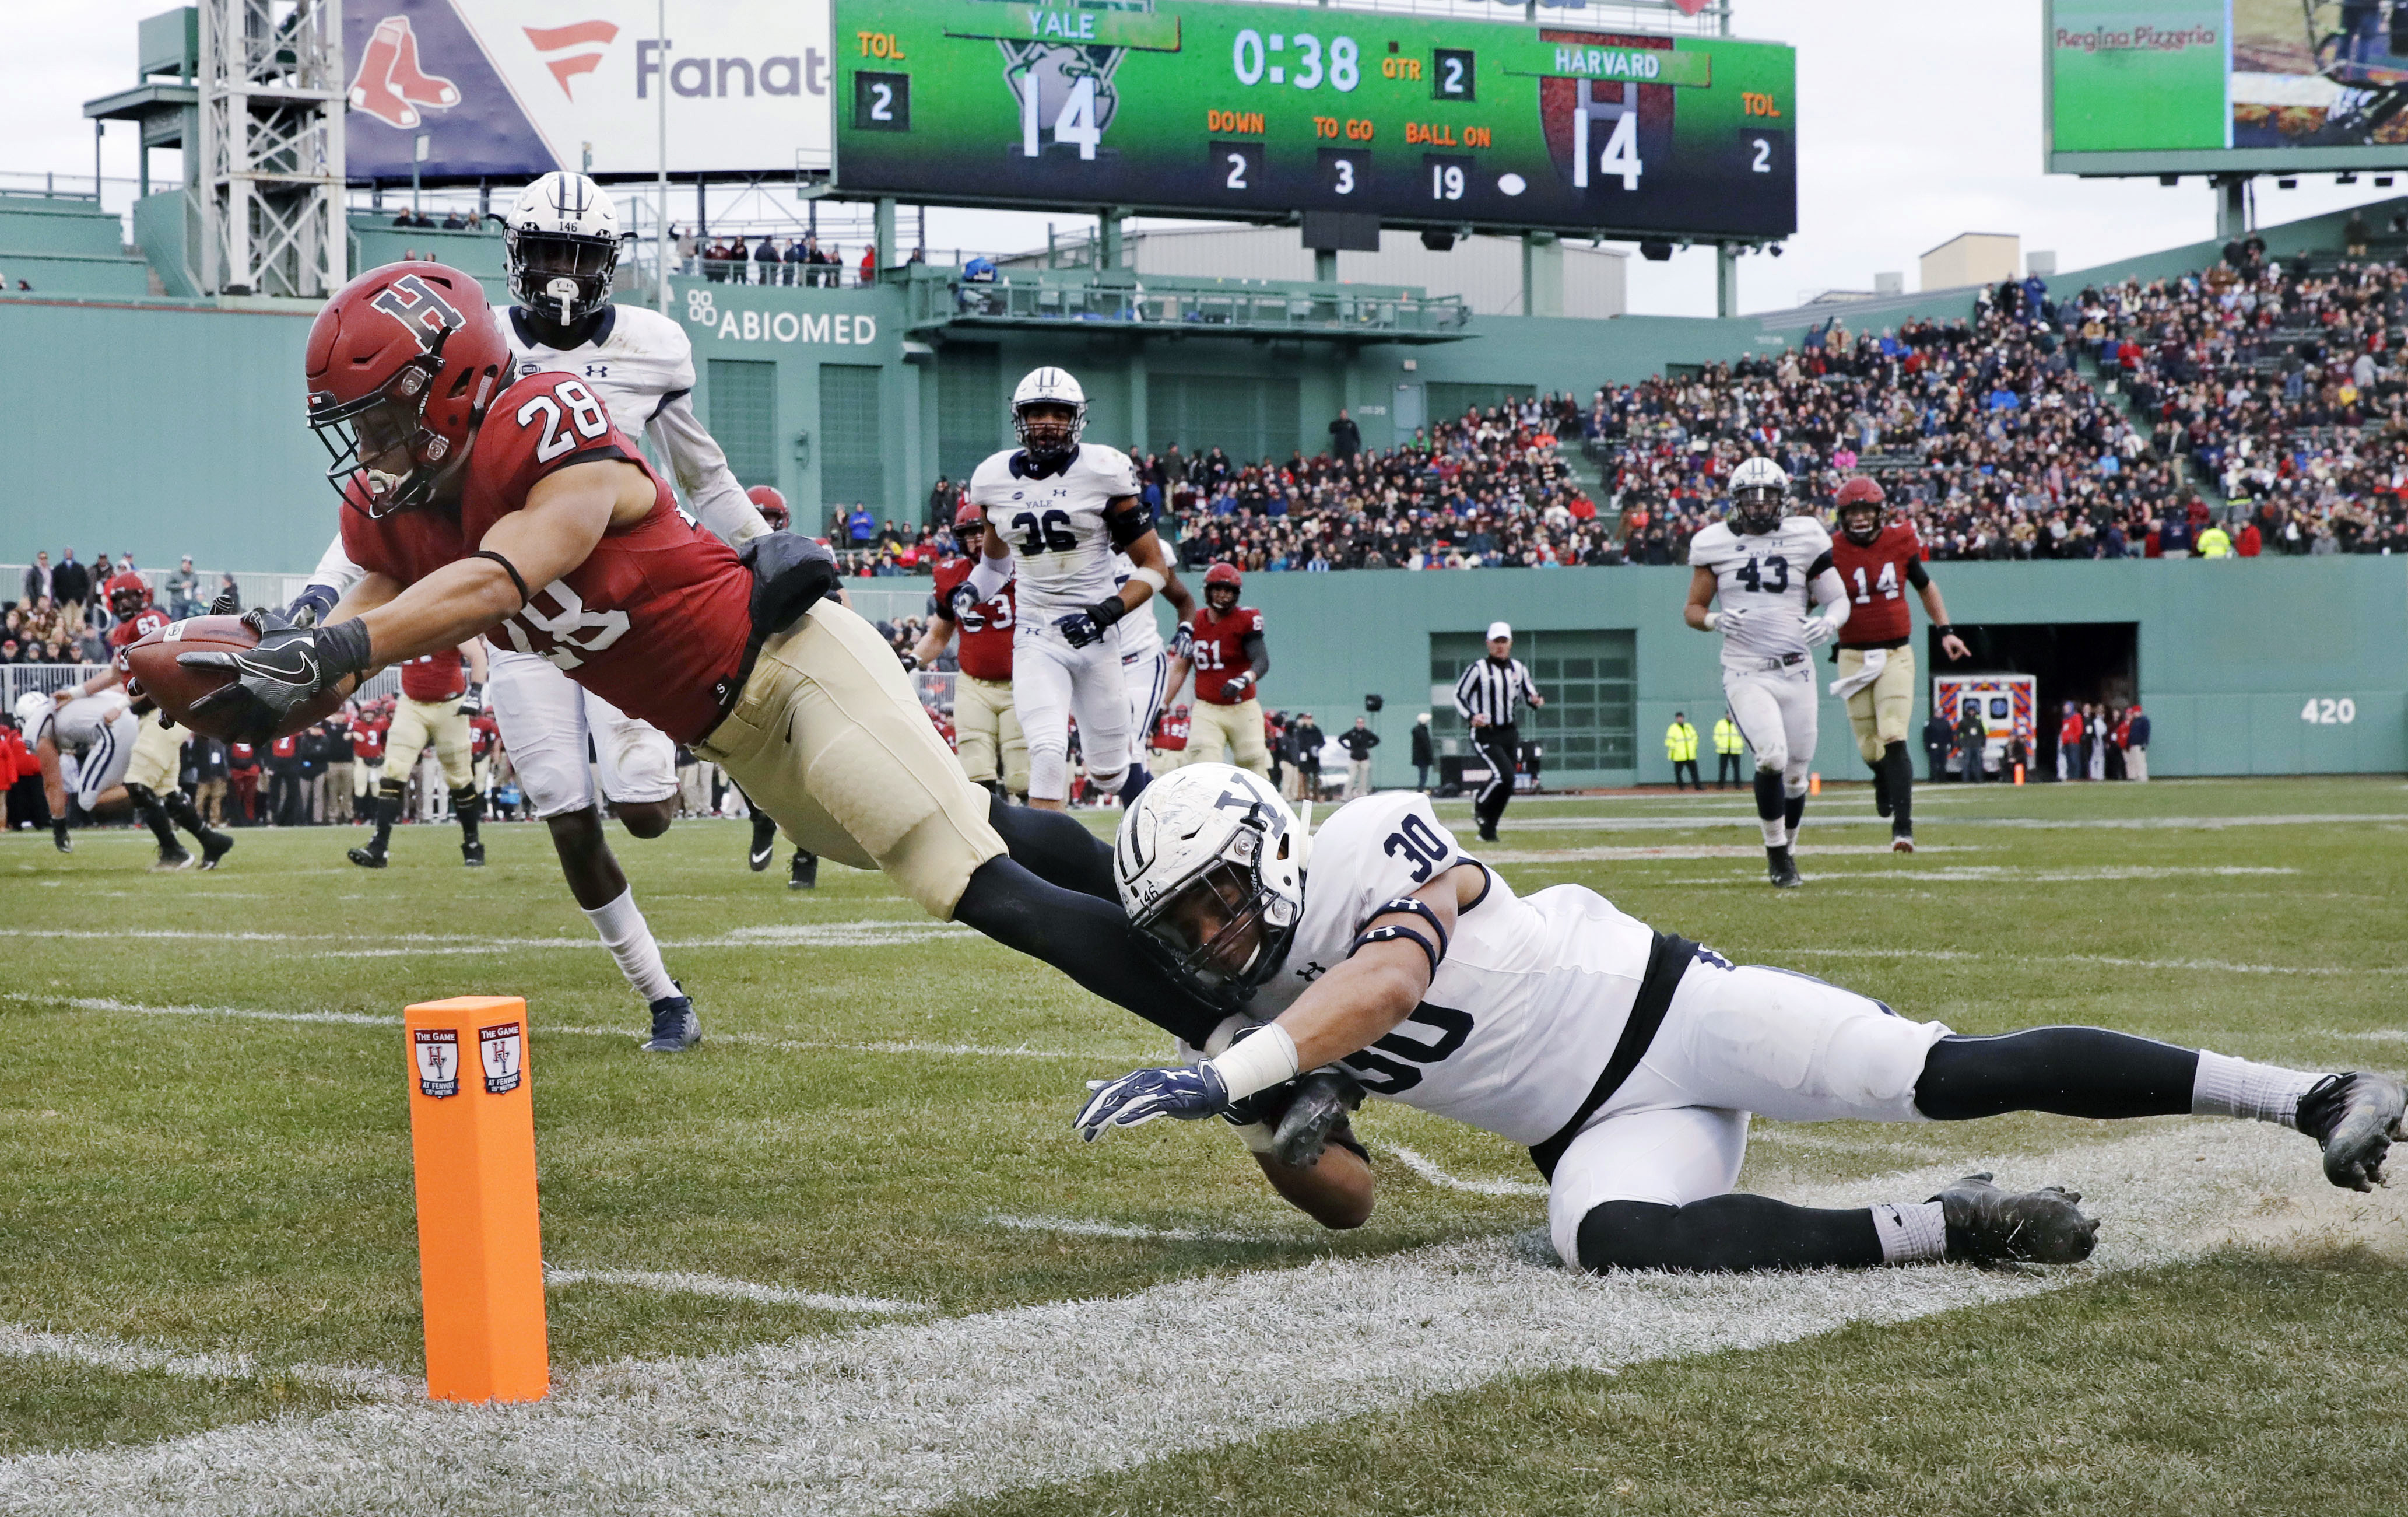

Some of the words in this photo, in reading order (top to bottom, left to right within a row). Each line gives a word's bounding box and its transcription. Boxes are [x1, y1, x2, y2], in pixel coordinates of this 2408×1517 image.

[1027, 10, 1096, 40] YALE
[2056, 27, 2129, 52] Regina
[2135, 25, 2214, 49] Pizzeria
[857, 31, 906, 60] TOL
[1233, 29, 1360, 92] 0:38
[1382, 57, 1422, 81] QTR
[1444, 57, 1464, 93] 2
[1554, 48, 1660, 79] HARVARD
[870, 83, 893, 121] 2
[1024, 73, 1101, 160] 14
[1742, 92, 1781, 117] TOL
[1208, 109, 1265, 135] DOWN
[1313, 116, 1339, 139] TO
[1346, 118, 1374, 141] GO
[1405, 122, 1458, 147] BALL
[1463, 126, 1491, 148] ON
[1574, 108, 1642, 191] 14
[1752, 138, 1772, 173] 2
[1227, 153, 1247, 189] 2
[1335, 159, 1354, 195] 3
[1433, 164, 1465, 200] 19
[559, 220, 578, 232] 146
[370, 274, 466, 354] H
[718, 310, 876, 345] ABIOMED
[517, 379, 609, 464] 28
[1026, 499, 1053, 509] YALE
[1012, 510, 1079, 555] 36
[1736, 556, 1788, 594] 43
[1852, 563, 1900, 604] 14
[136, 614, 161, 636] 63
[1194, 640, 1224, 670] 61
[2300, 698, 2356, 724] 420
[367, 730, 378, 745] 3
[1214, 773, 1287, 840] Y
[1383, 813, 1448, 883] 30
[416, 1032, 431, 1041] THE
[433, 1032, 455, 1041] GAME
[481, 1030, 496, 1039] THE
[497, 1026, 519, 1036] GAME
[432, 1081, 454, 1089] FENWAY
[496, 1074, 518, 1085] FENWAY
